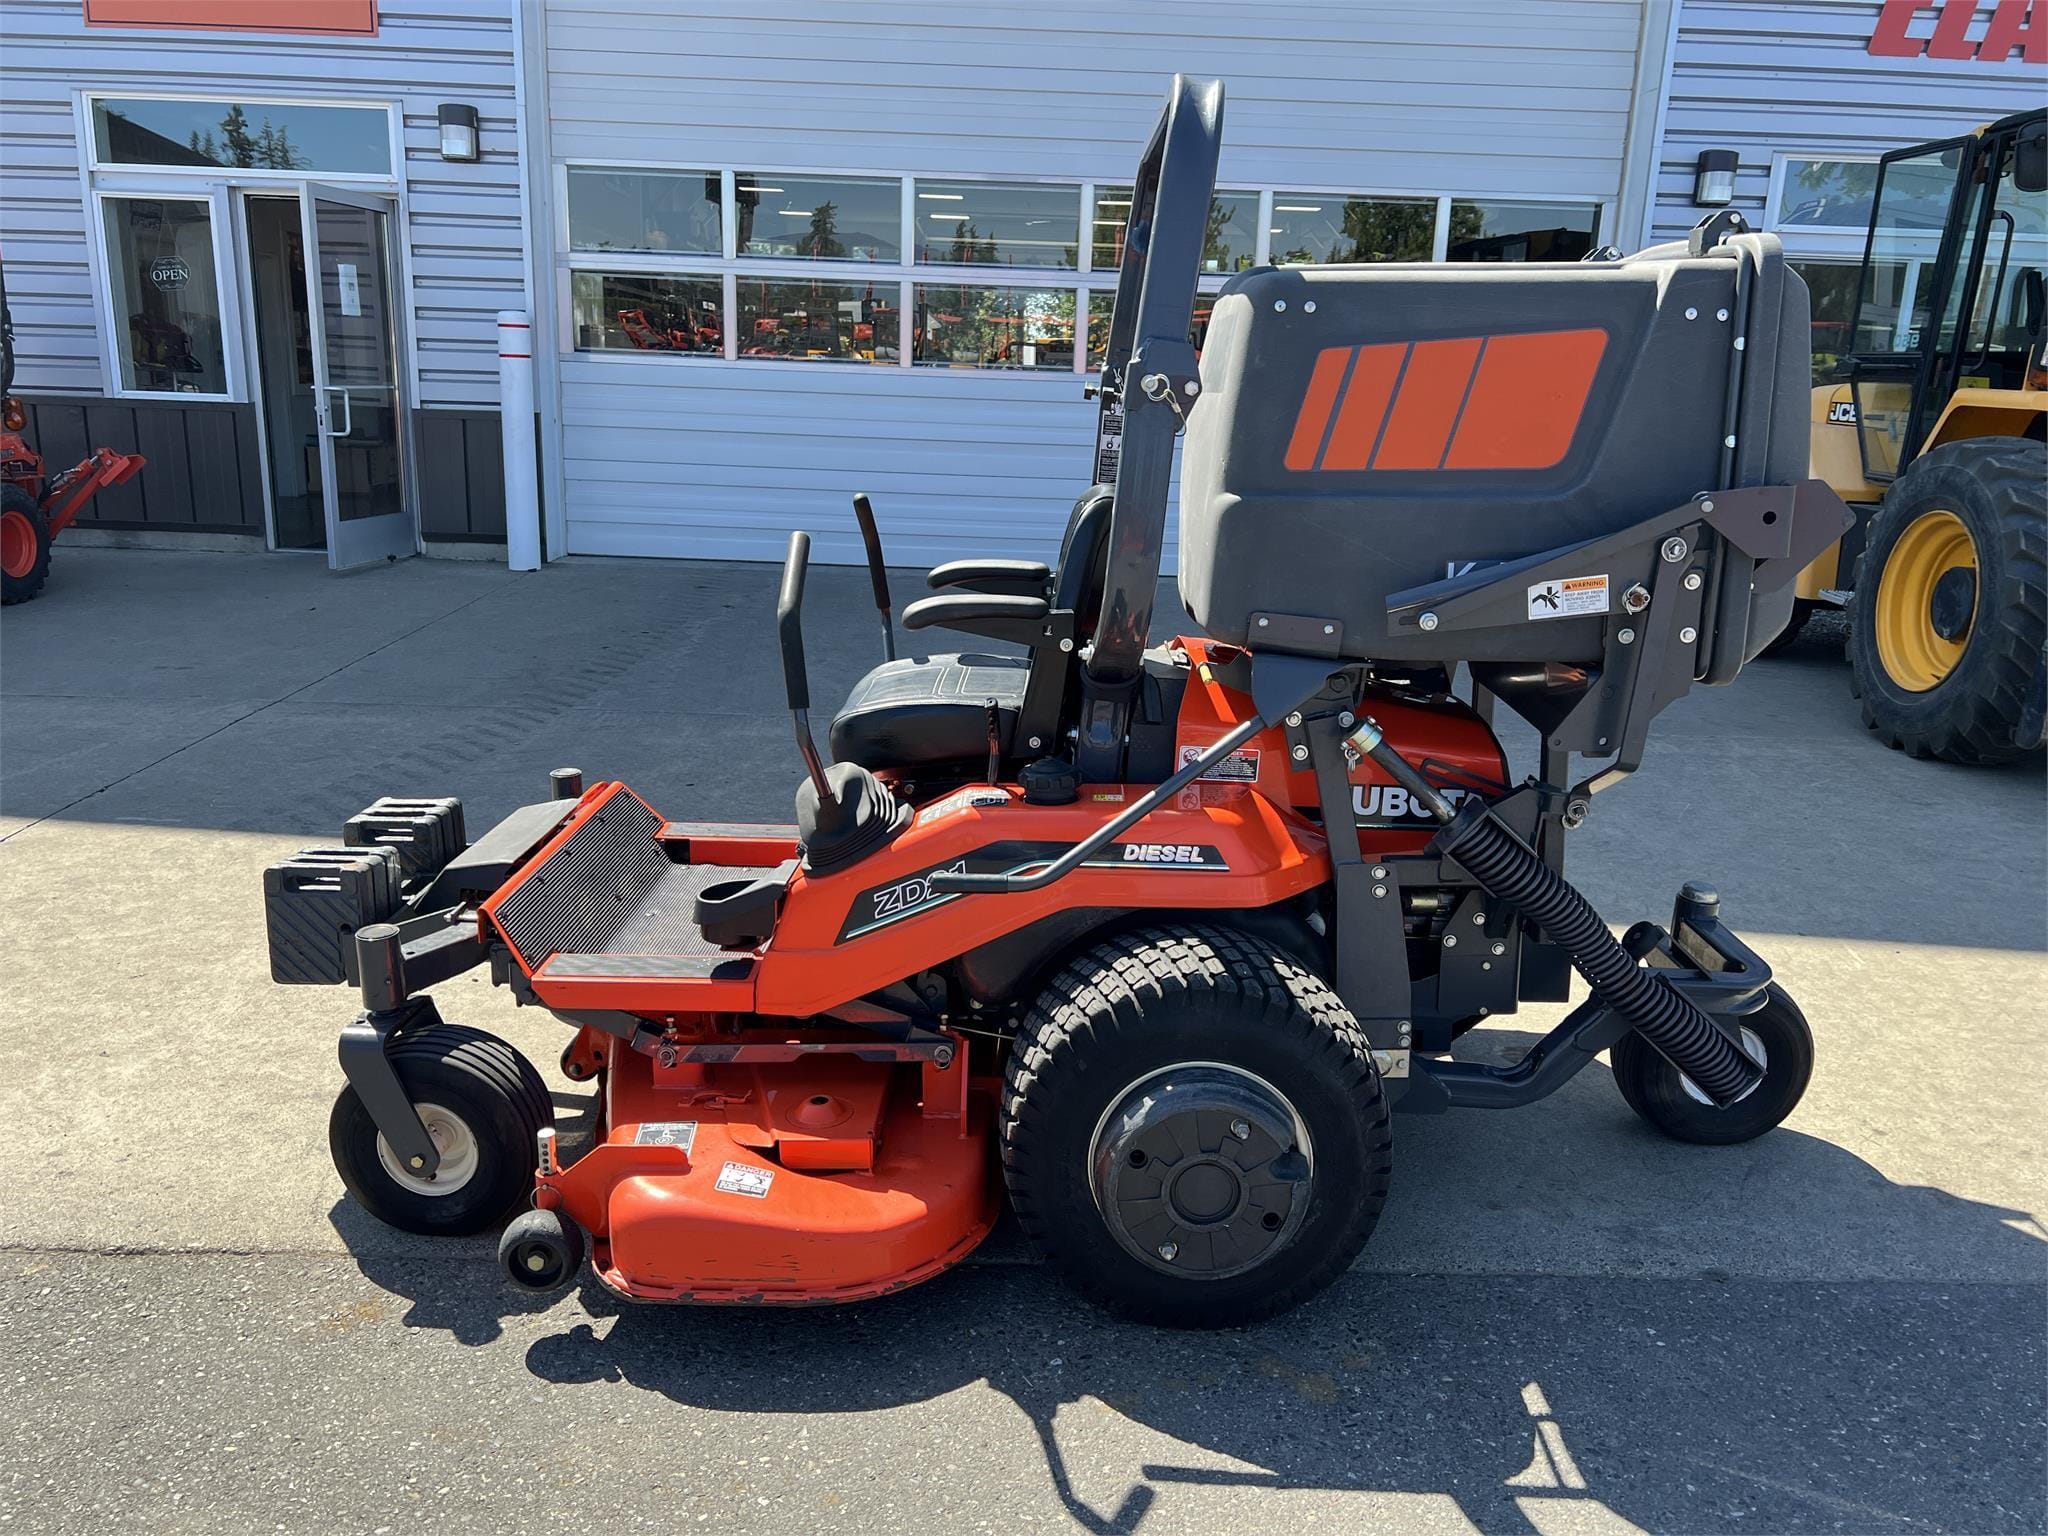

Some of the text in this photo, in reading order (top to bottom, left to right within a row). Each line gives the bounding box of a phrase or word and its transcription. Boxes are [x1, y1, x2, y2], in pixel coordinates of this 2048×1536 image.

[152, 269, 188, 281] OPEN
[1572, 580, 1604, 590] WARNING
[1352, 785, 1484, 818] UBT
[1123, 844, 1204, 863] DIESEL
[734, 1164, 772, 1178] DANGER
